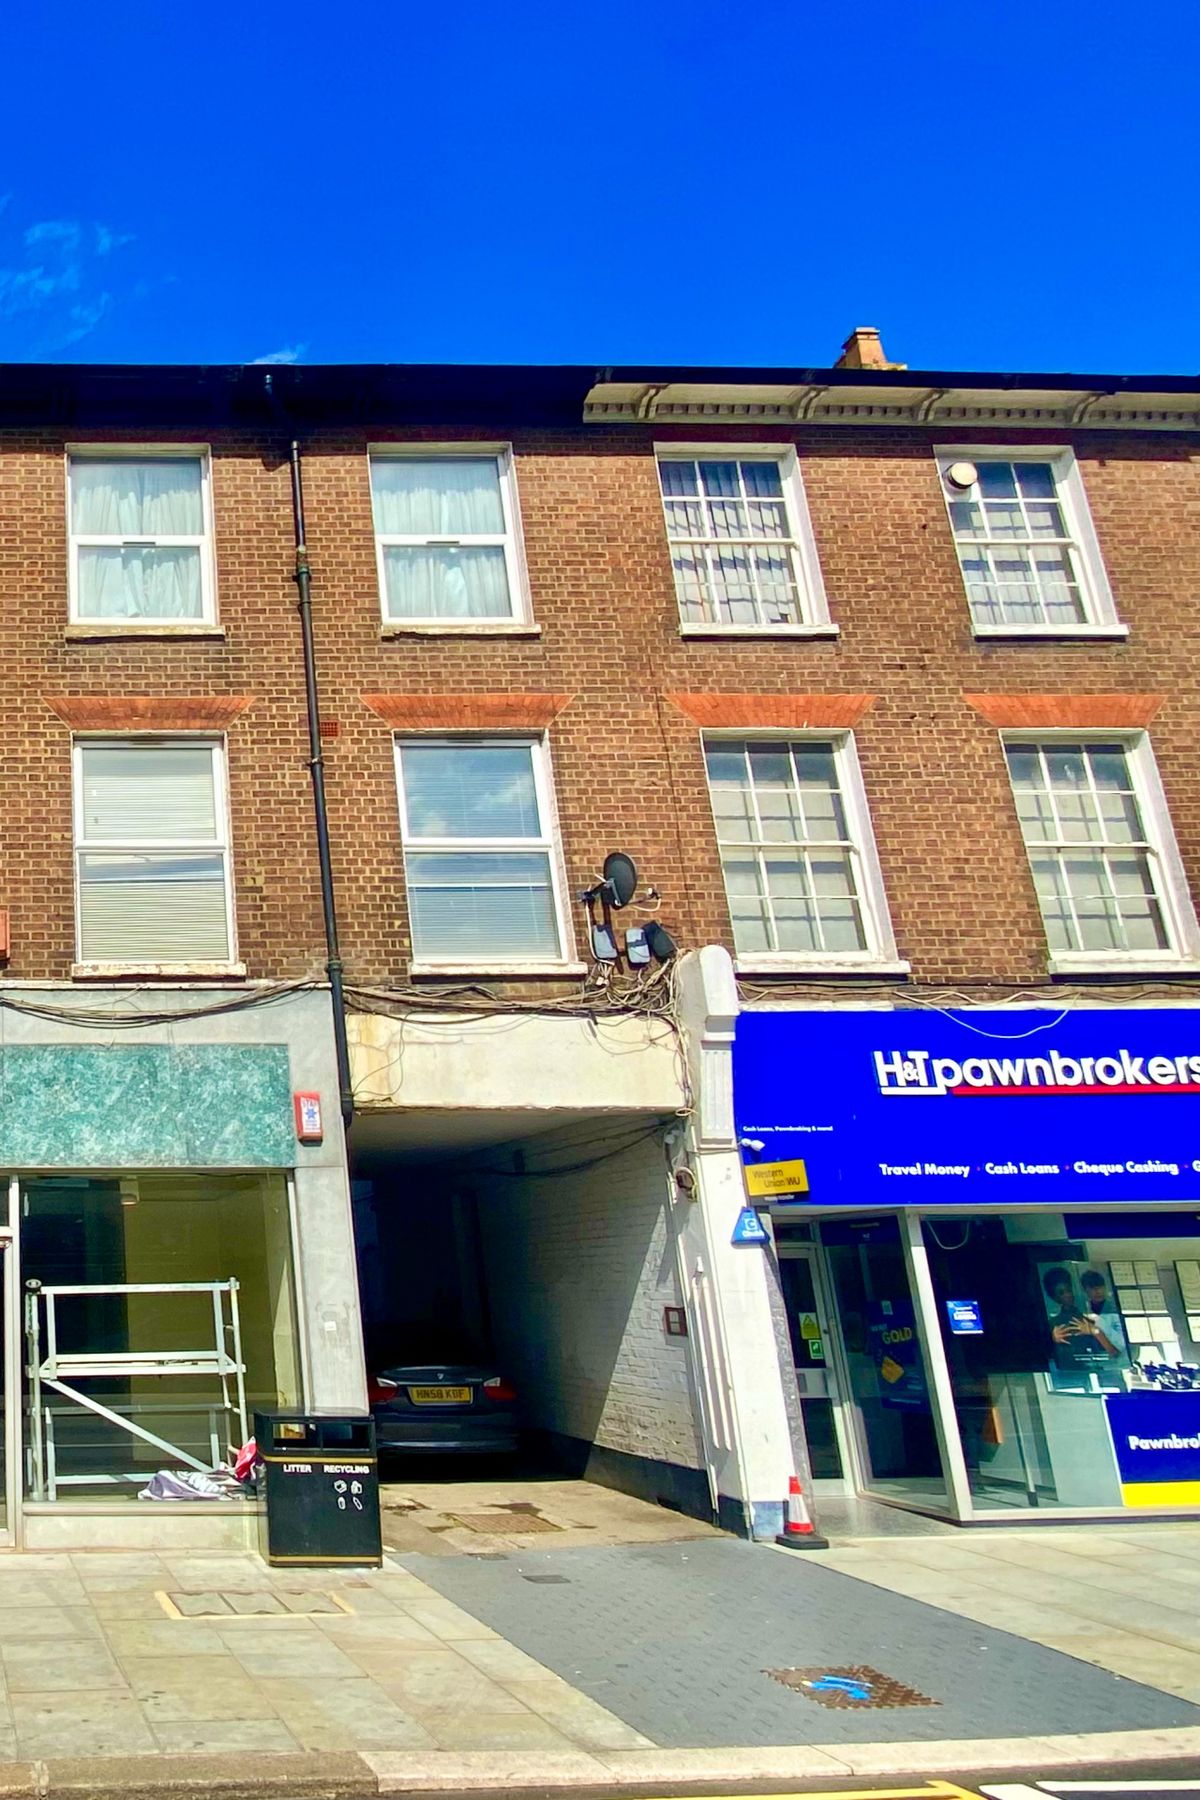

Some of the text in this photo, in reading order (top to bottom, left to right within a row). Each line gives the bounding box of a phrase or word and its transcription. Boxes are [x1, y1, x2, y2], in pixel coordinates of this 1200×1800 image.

[752, 1169, 784, 1178] Western
[879, 1162, 970, 1178] Travel Money
[985, 1162, 1060, 1174] Cash Loans
[1073, 1160, 1179, 1176] Cheque Cashing
[882, 1327, 912, 1344] GOLD
[1128, 1433, 1200, 1450] Pawnbro
[283, 1464, 370, 1474] LITTER RECYCLING
